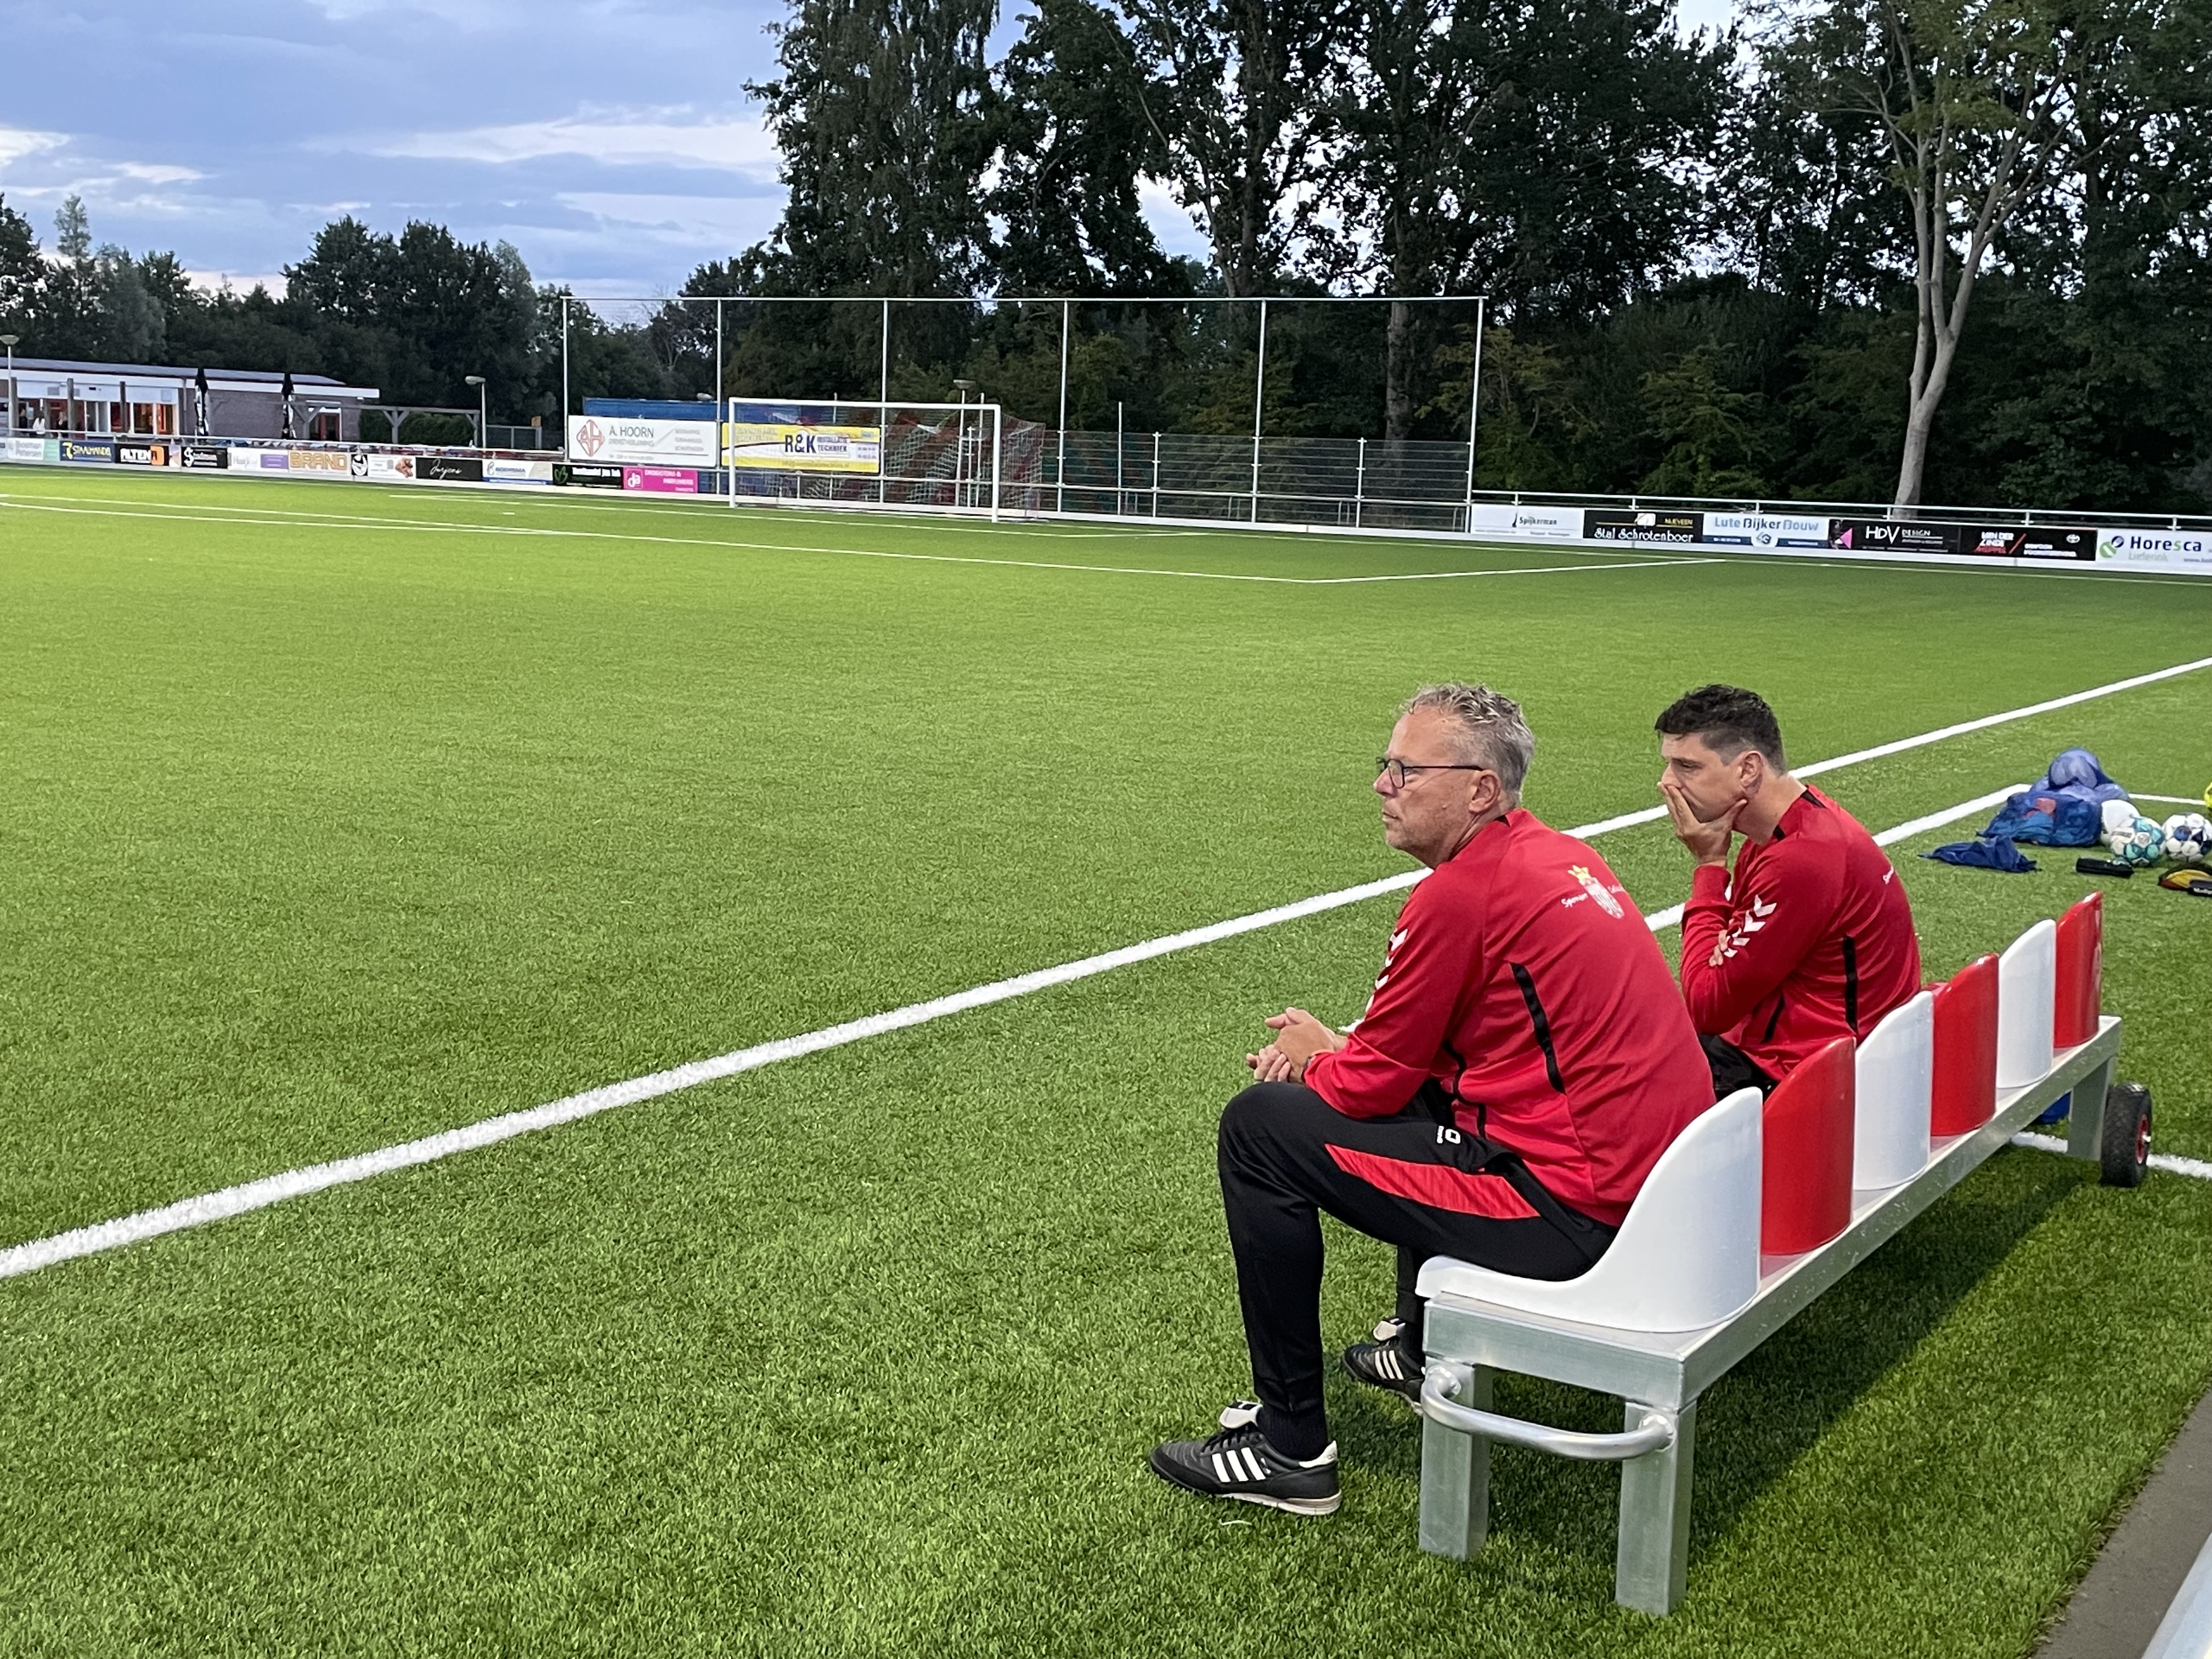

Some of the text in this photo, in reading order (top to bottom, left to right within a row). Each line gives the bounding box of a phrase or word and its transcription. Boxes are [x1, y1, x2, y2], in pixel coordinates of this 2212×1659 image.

[620, 426, 654, 438] HOORN
[785, 435, 816, 453] R&K
[290, 452, 348, 470] BRAND
[1715, 516, 1819, 531] Lute Bijker Bouw
[1594, 527, 1694, 543] Stal Schrotenboer
[2130, 536, 2202, 552] Horesca
